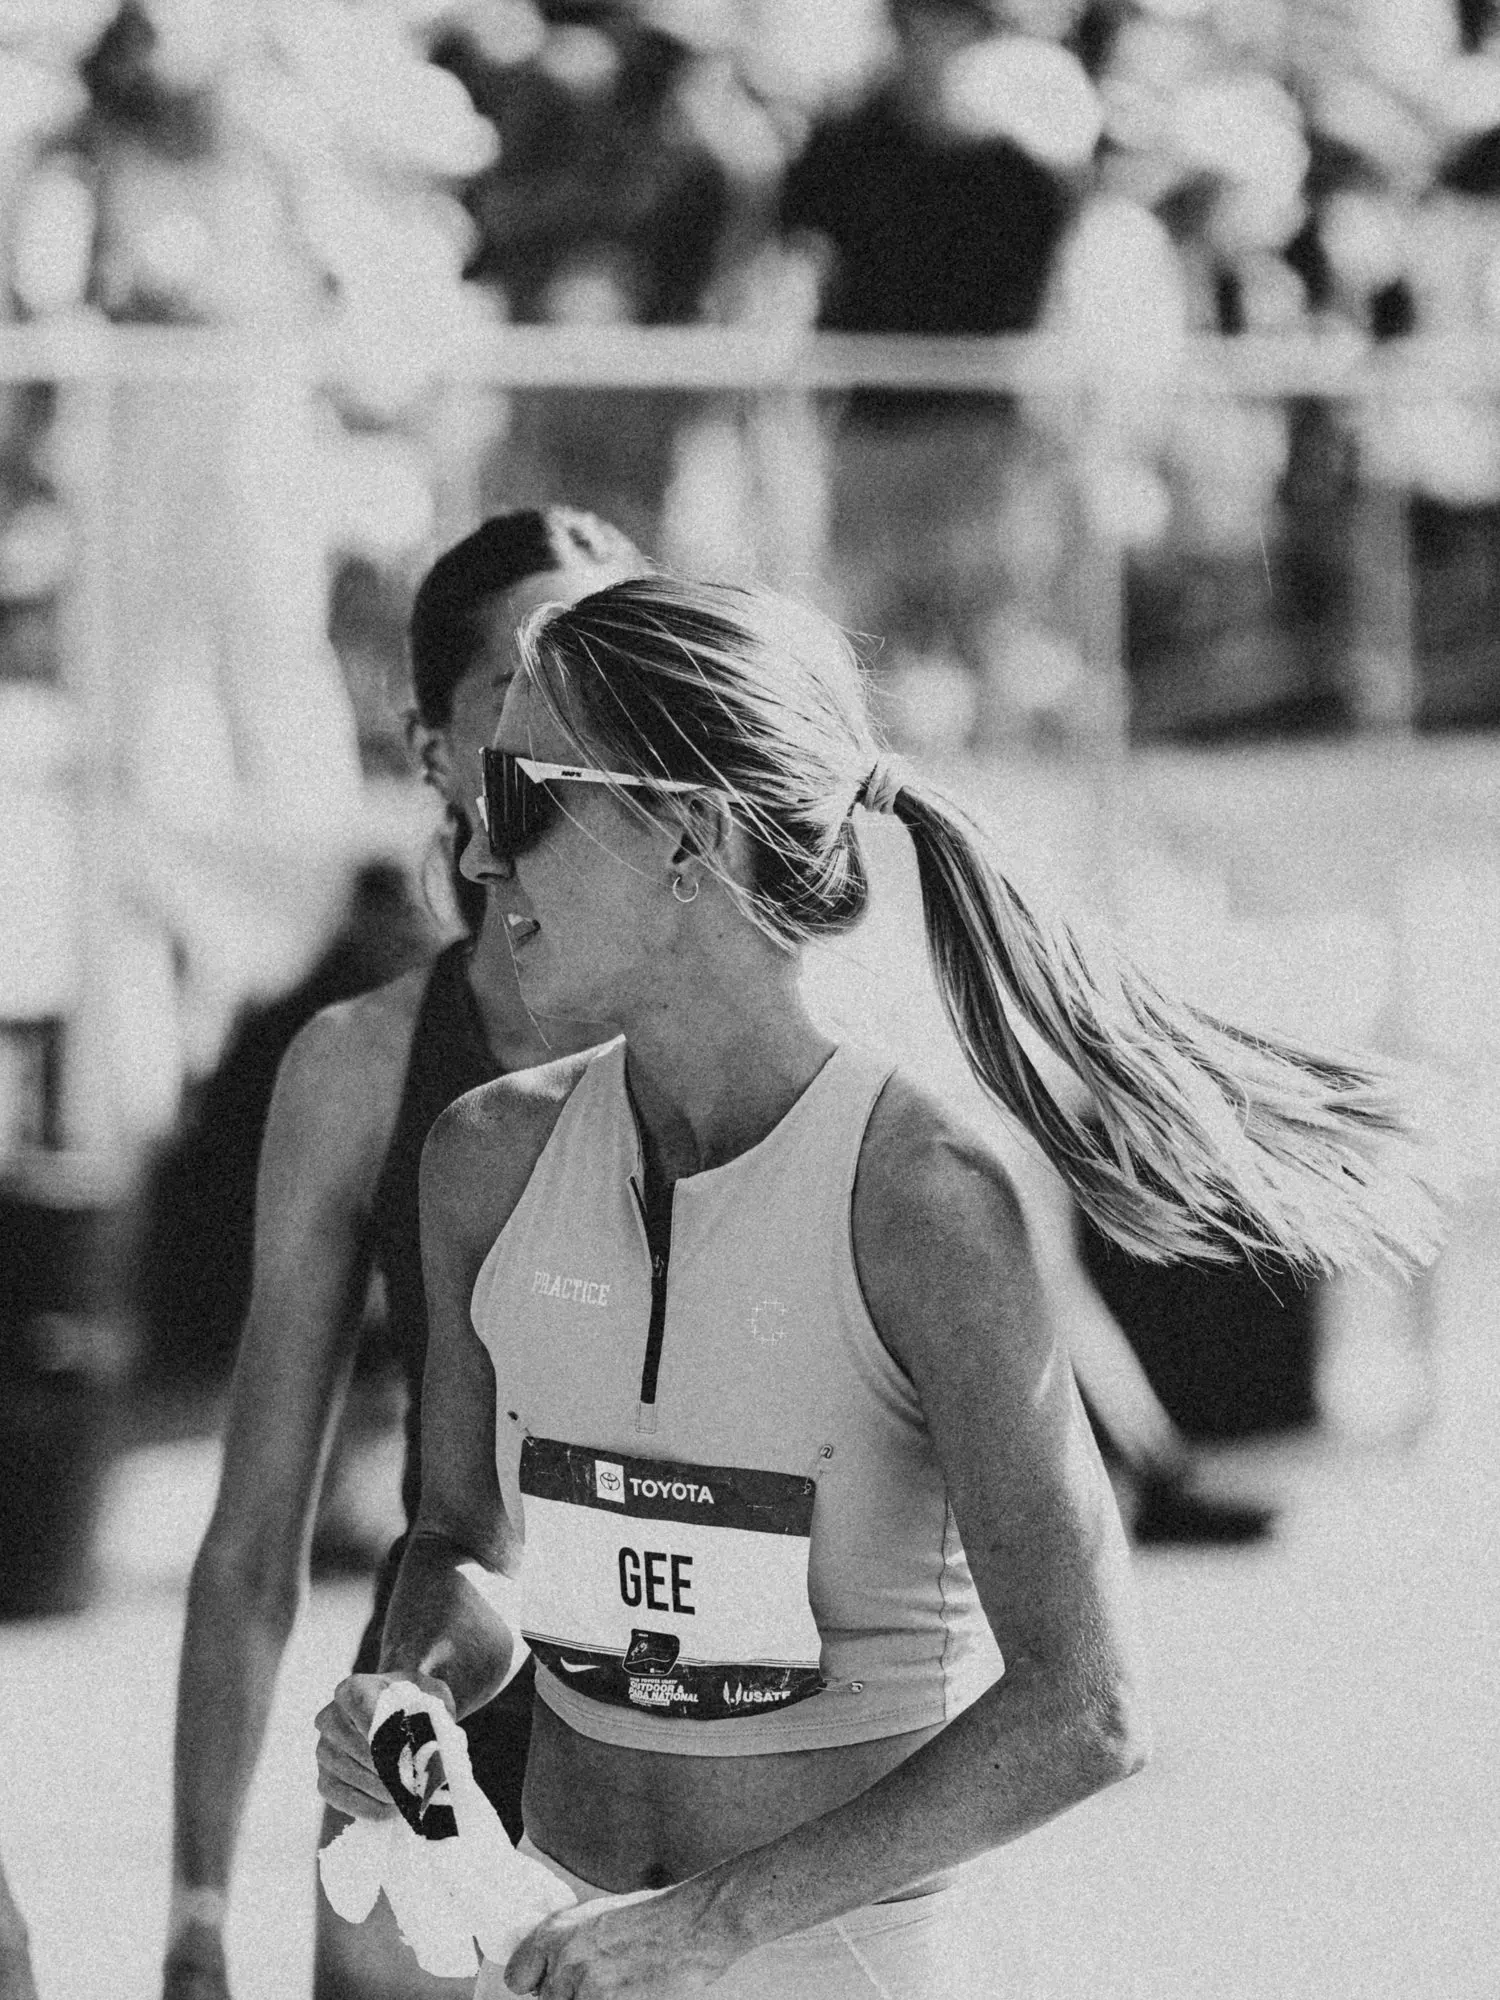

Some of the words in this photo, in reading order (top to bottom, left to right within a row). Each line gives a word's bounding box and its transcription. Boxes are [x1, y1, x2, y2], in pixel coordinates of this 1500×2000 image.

[532, 1271, 610, 1306] PRACTICE
[629, 1477, 714, 1504] TOYOTA
[618, 1547, 696, 1615] GEE
[651, 1691, 699, 1703] NATIONAL
[742, 1690, 791, 1703] USATF
